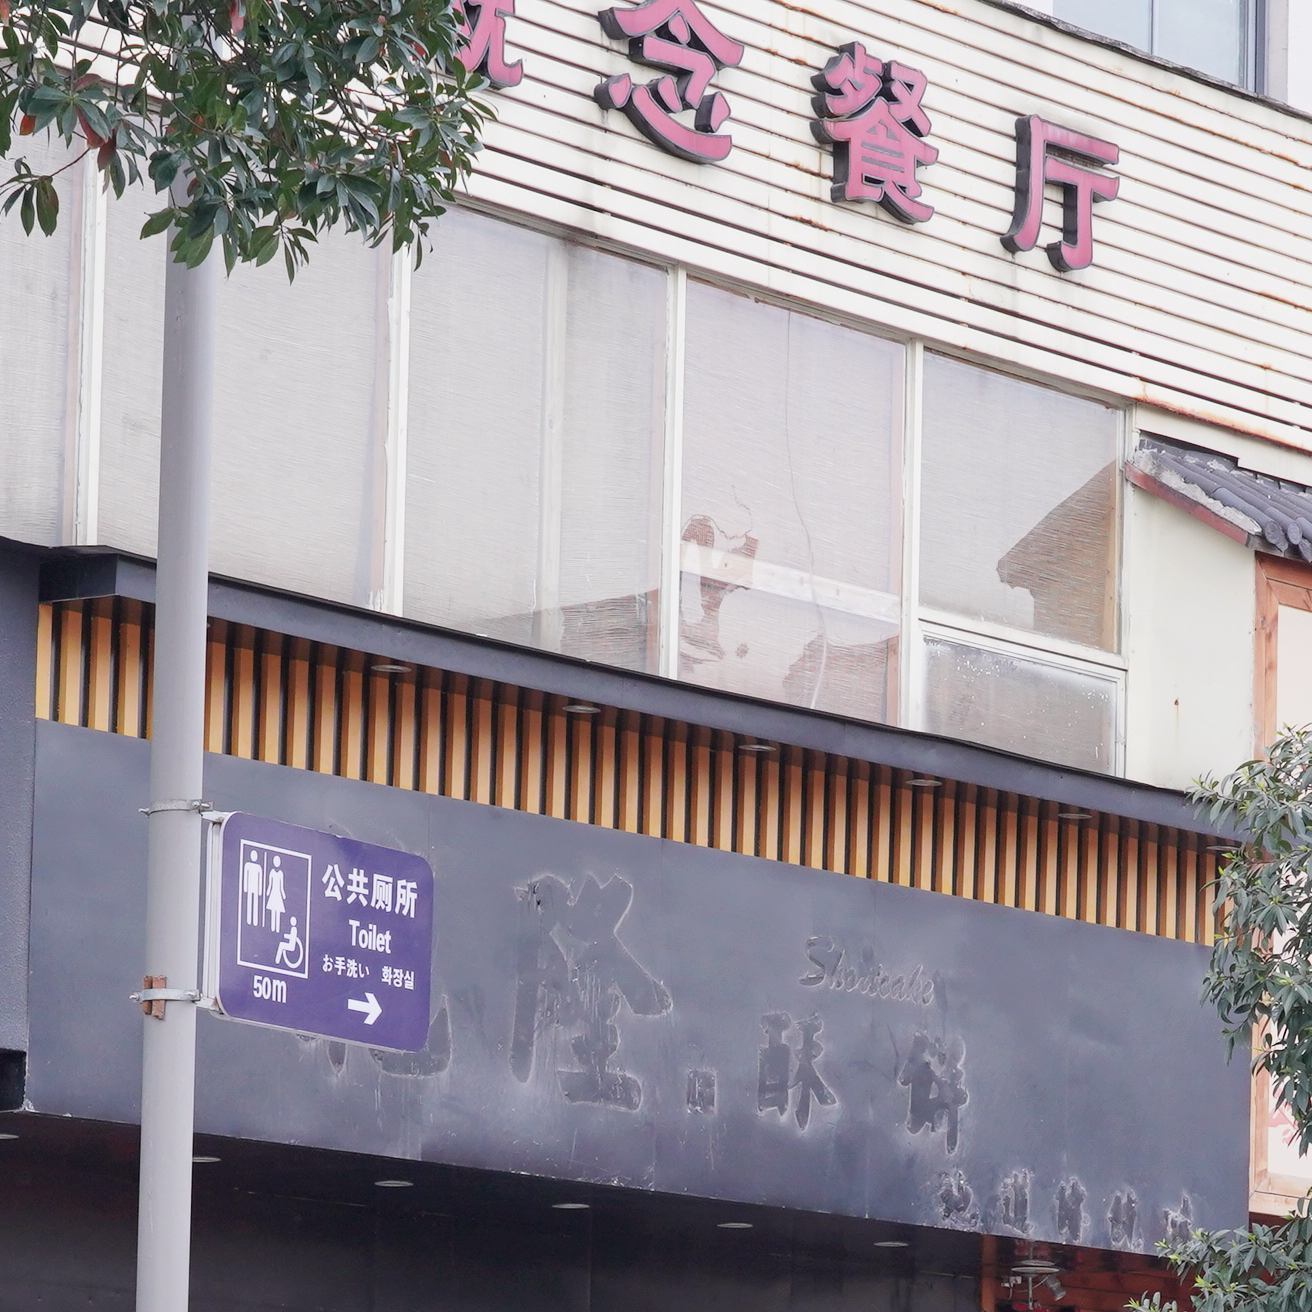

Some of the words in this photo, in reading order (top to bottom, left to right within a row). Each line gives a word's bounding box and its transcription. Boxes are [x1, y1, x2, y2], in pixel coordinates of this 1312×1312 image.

[321, 863, 418, 919] 公共厕所
[348, 918, 392, 955] Toilet
[322, 953, 371, 979] お手洗い
[380, 965, 416, 990] 화장실
[252, 974, 288, 1004] 50m
